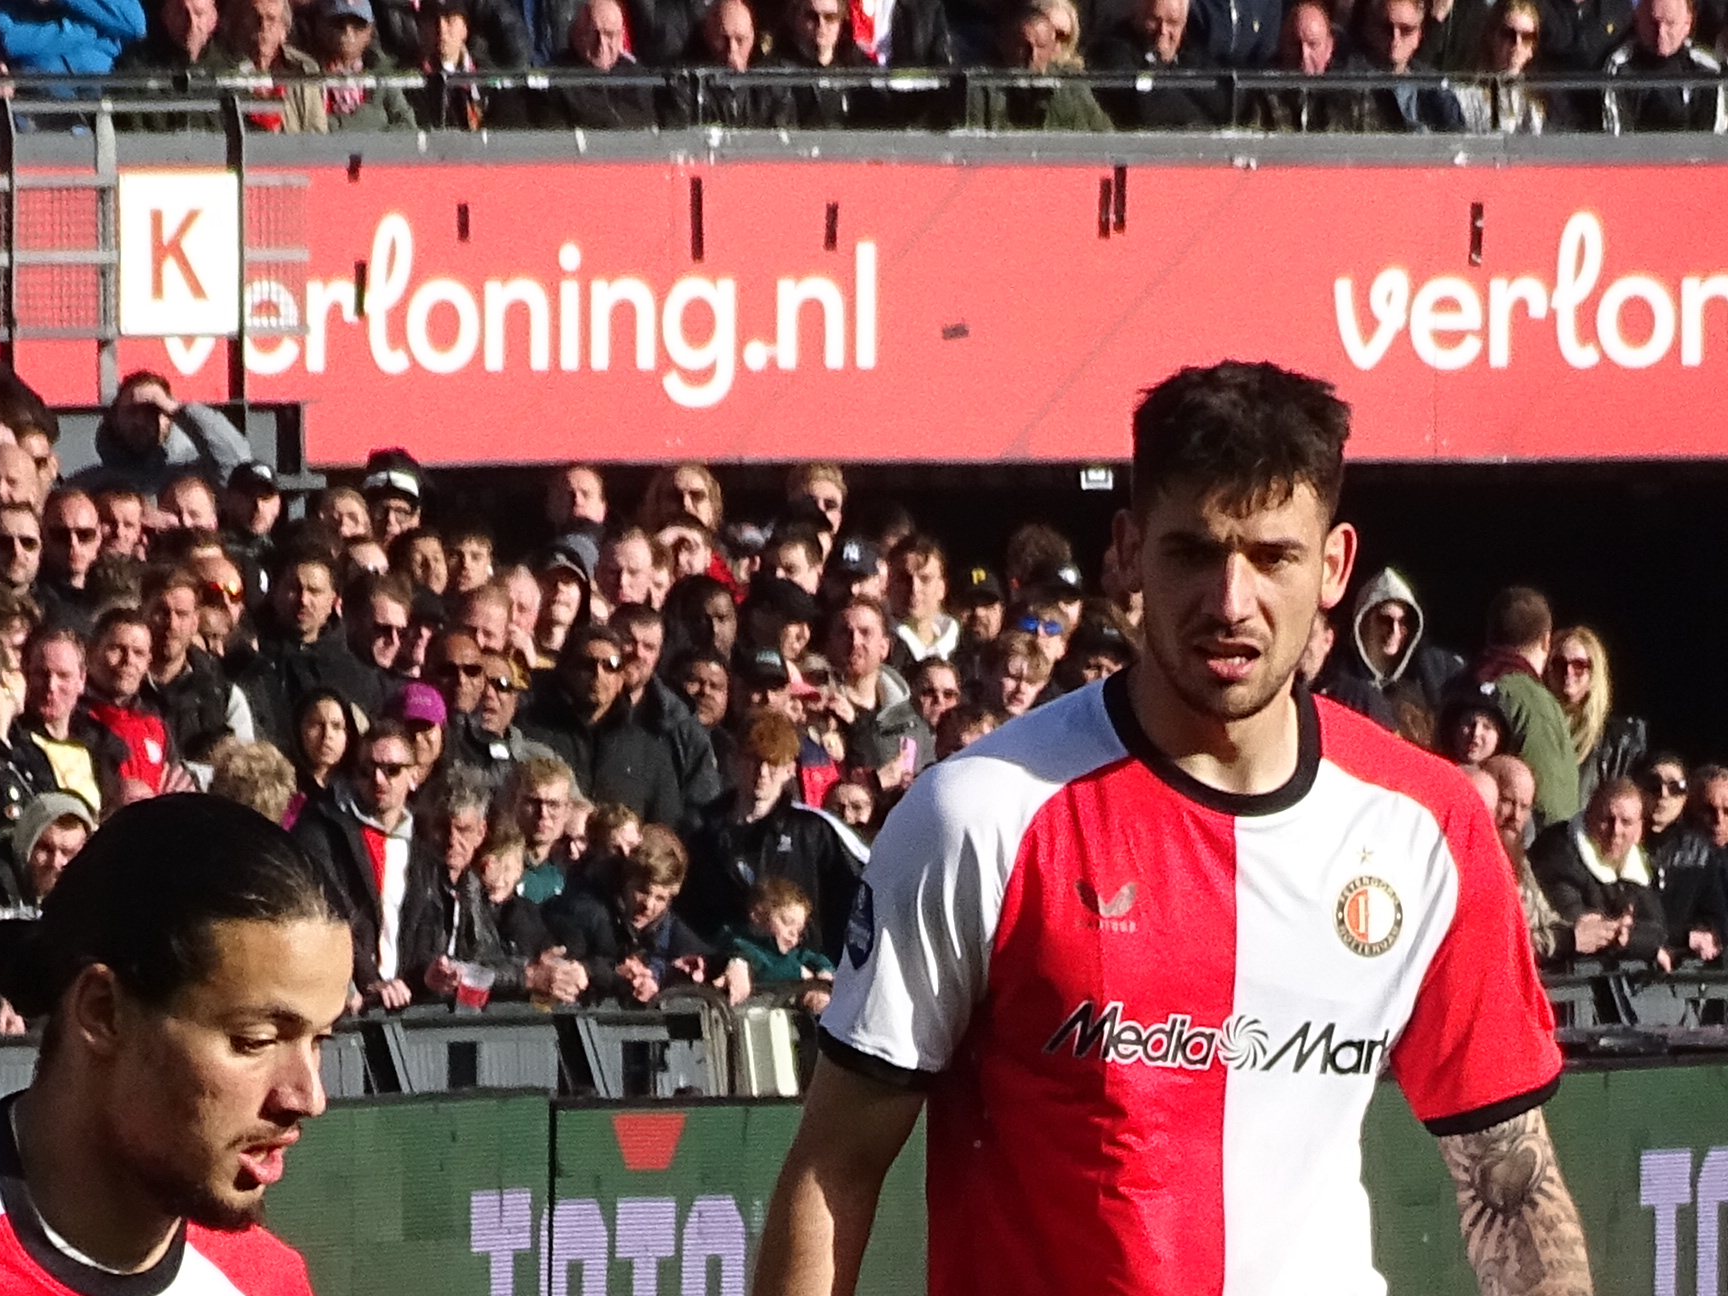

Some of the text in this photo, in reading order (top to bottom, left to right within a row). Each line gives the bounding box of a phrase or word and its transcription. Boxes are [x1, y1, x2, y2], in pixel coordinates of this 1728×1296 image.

[148, 208, 206, 302] K
[163, 212, 878, 408] erloning.nl
[1040, 1000, 1218, 1070] Media
